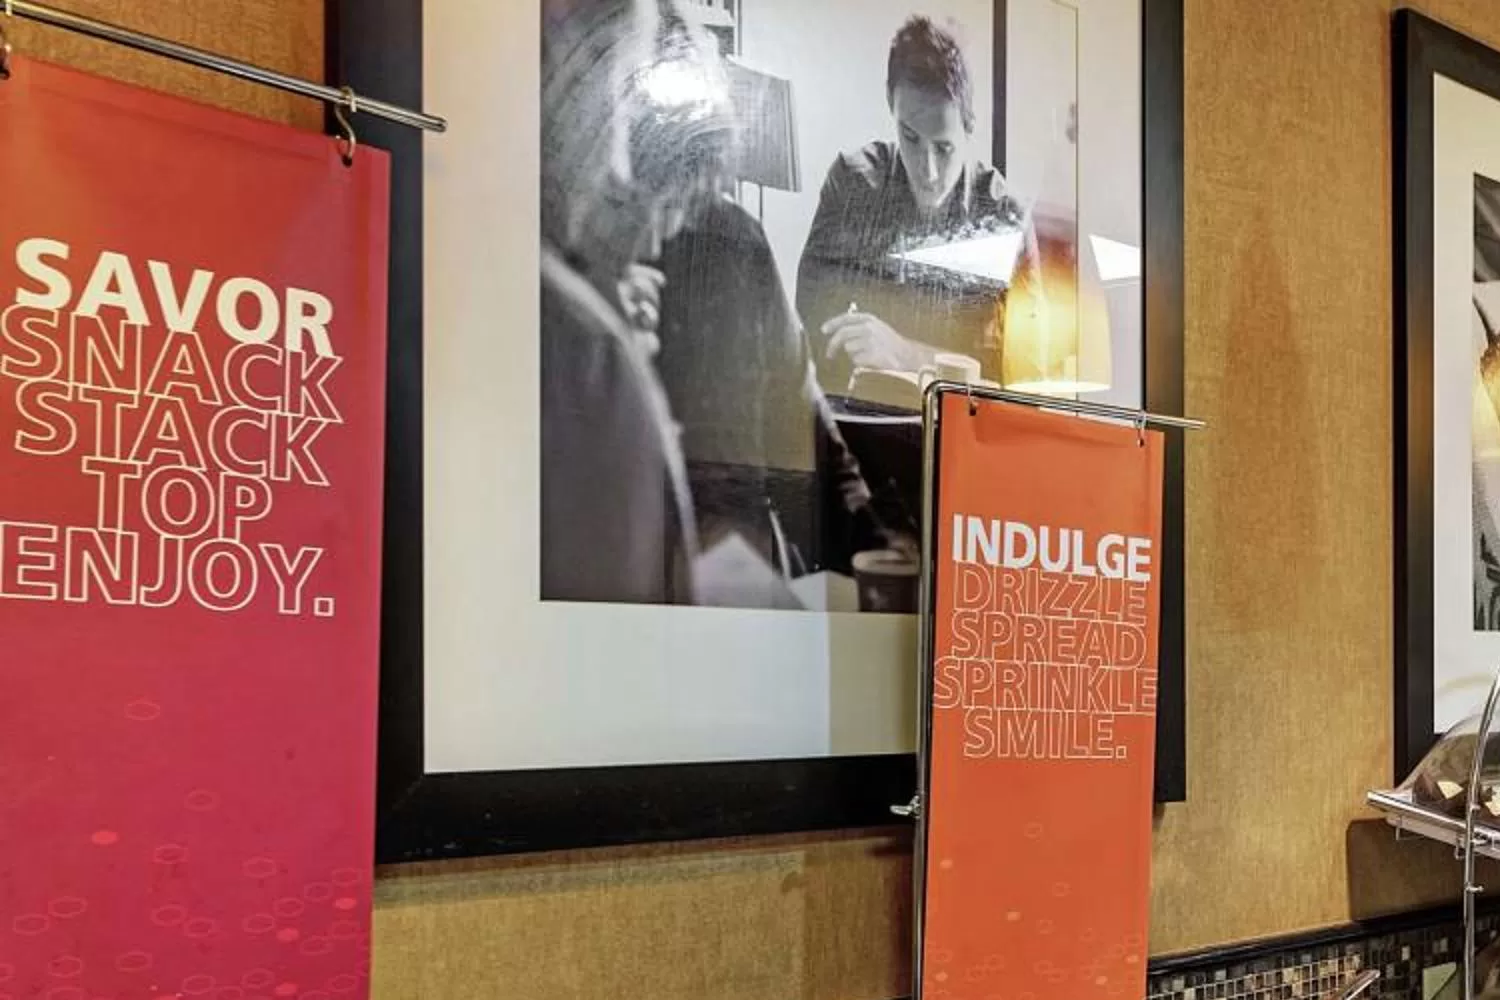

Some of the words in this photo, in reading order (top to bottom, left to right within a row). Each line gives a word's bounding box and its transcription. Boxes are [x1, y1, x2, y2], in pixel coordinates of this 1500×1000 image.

[14, 237, 335, 358] SAVOR
[0, 304, 344, 424] SNACK
[14, 378, 330, 486] STACK
[82, 455, 273, 543] TOP
[0, 520, 335, 617] ENJOY.
[952, 513, 1152, 582] INDULGE
[953, 560, 1148, 627] DRIZZLE
[951, 610, 1148, 671] SPREAD
[932, 655, 1158, 716] SPRINKLE
[963, 705, 1127, 759] SMILE.
